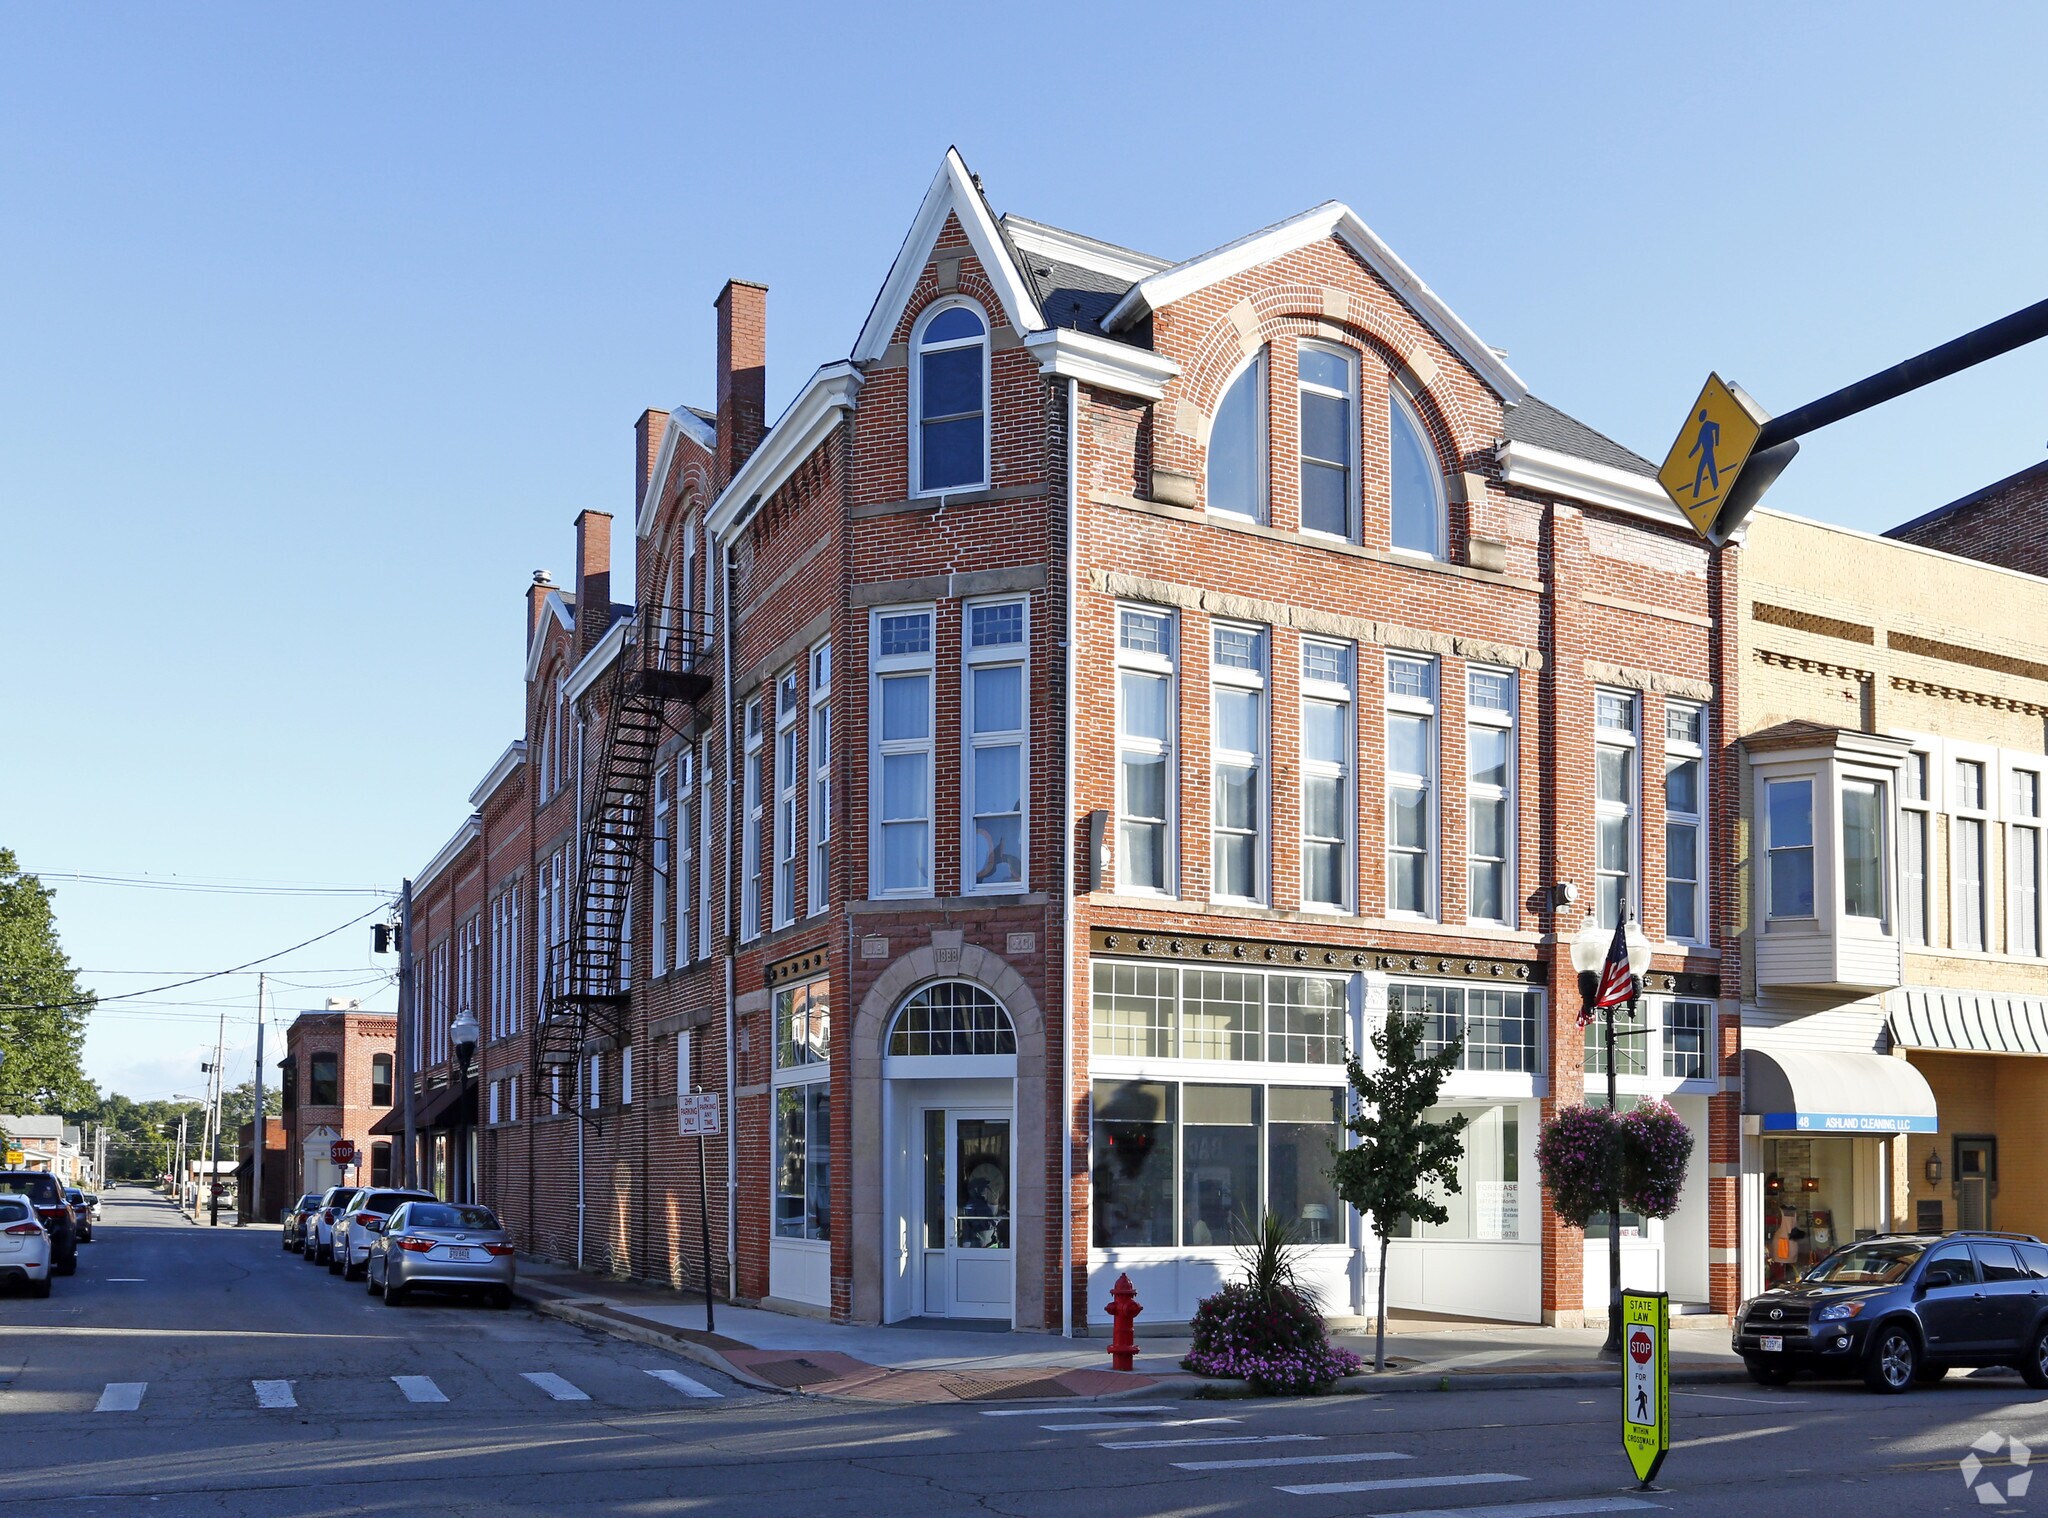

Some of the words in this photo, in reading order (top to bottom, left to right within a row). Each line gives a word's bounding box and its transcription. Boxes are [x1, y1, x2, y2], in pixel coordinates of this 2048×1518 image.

[936, 948, 959, 963] 1888
[680, 1107, 698, 1115] PARKING
[1798, 1116, 1810, 1128] 48
[1825, 1118, 1858, 1129] ASHLAND
[1860, 1119, 1896, 1131] CLEANING,
[1897, 1120, 1911, 1130] LLC
[332, 1148, 352, 1158] STOP
[1630, 1300, 1652, 1311] STATE
[1633, 1312, 1648, 1322] LAW
[1631, 1341, 1650, 1354] STOP
[1635, 1372, 1646, 1381] FOR
[1633, 1426, 1649, 1436] WITHIN
[1627, 1434, 1656, 1446] CROSSWALK
